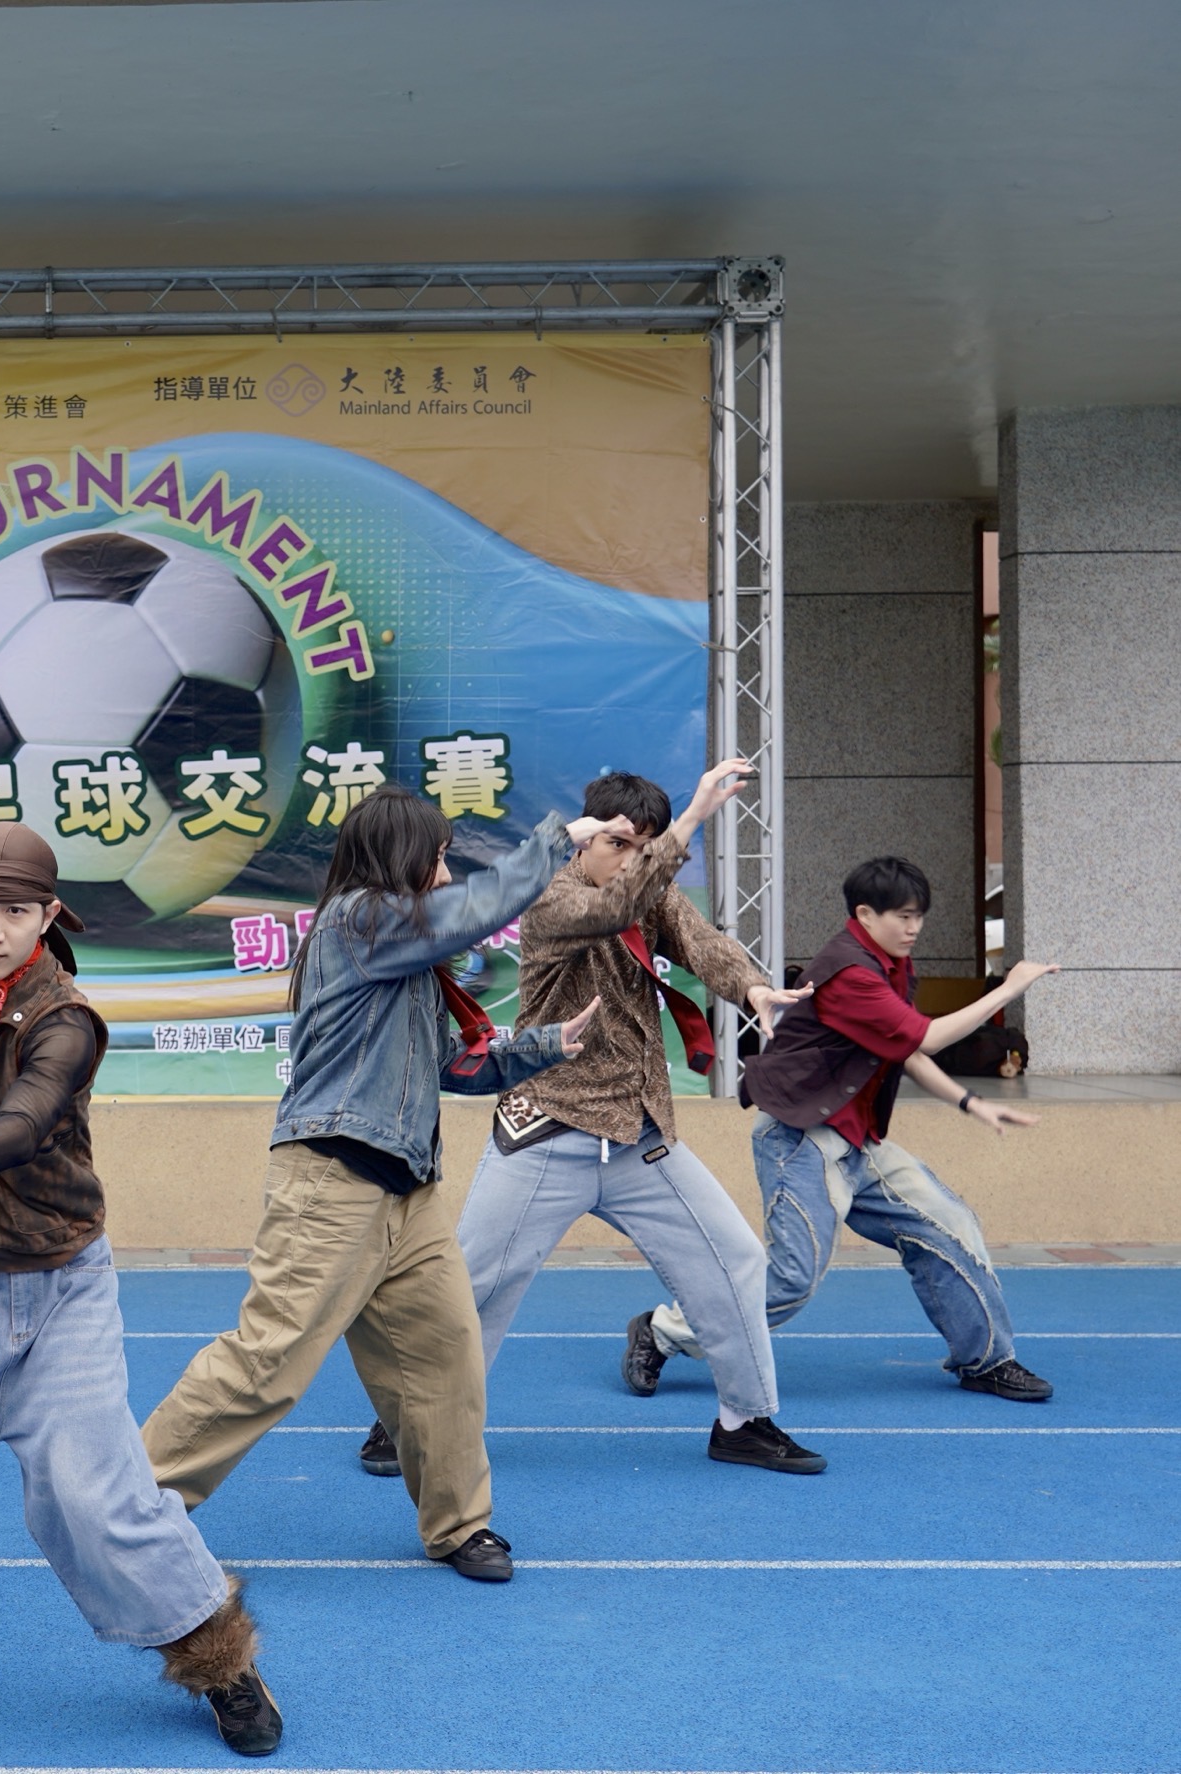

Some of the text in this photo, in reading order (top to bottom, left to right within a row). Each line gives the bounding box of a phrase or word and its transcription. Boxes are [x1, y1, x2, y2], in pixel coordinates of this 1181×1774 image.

[153, 375, 258, 401] 指導單位
[338, 365, 537, 395] 大陸委員會
[339, 399, 532, 415] Mainland Affairs Council
[155, 1026, 263, 1051] 協辦單位
